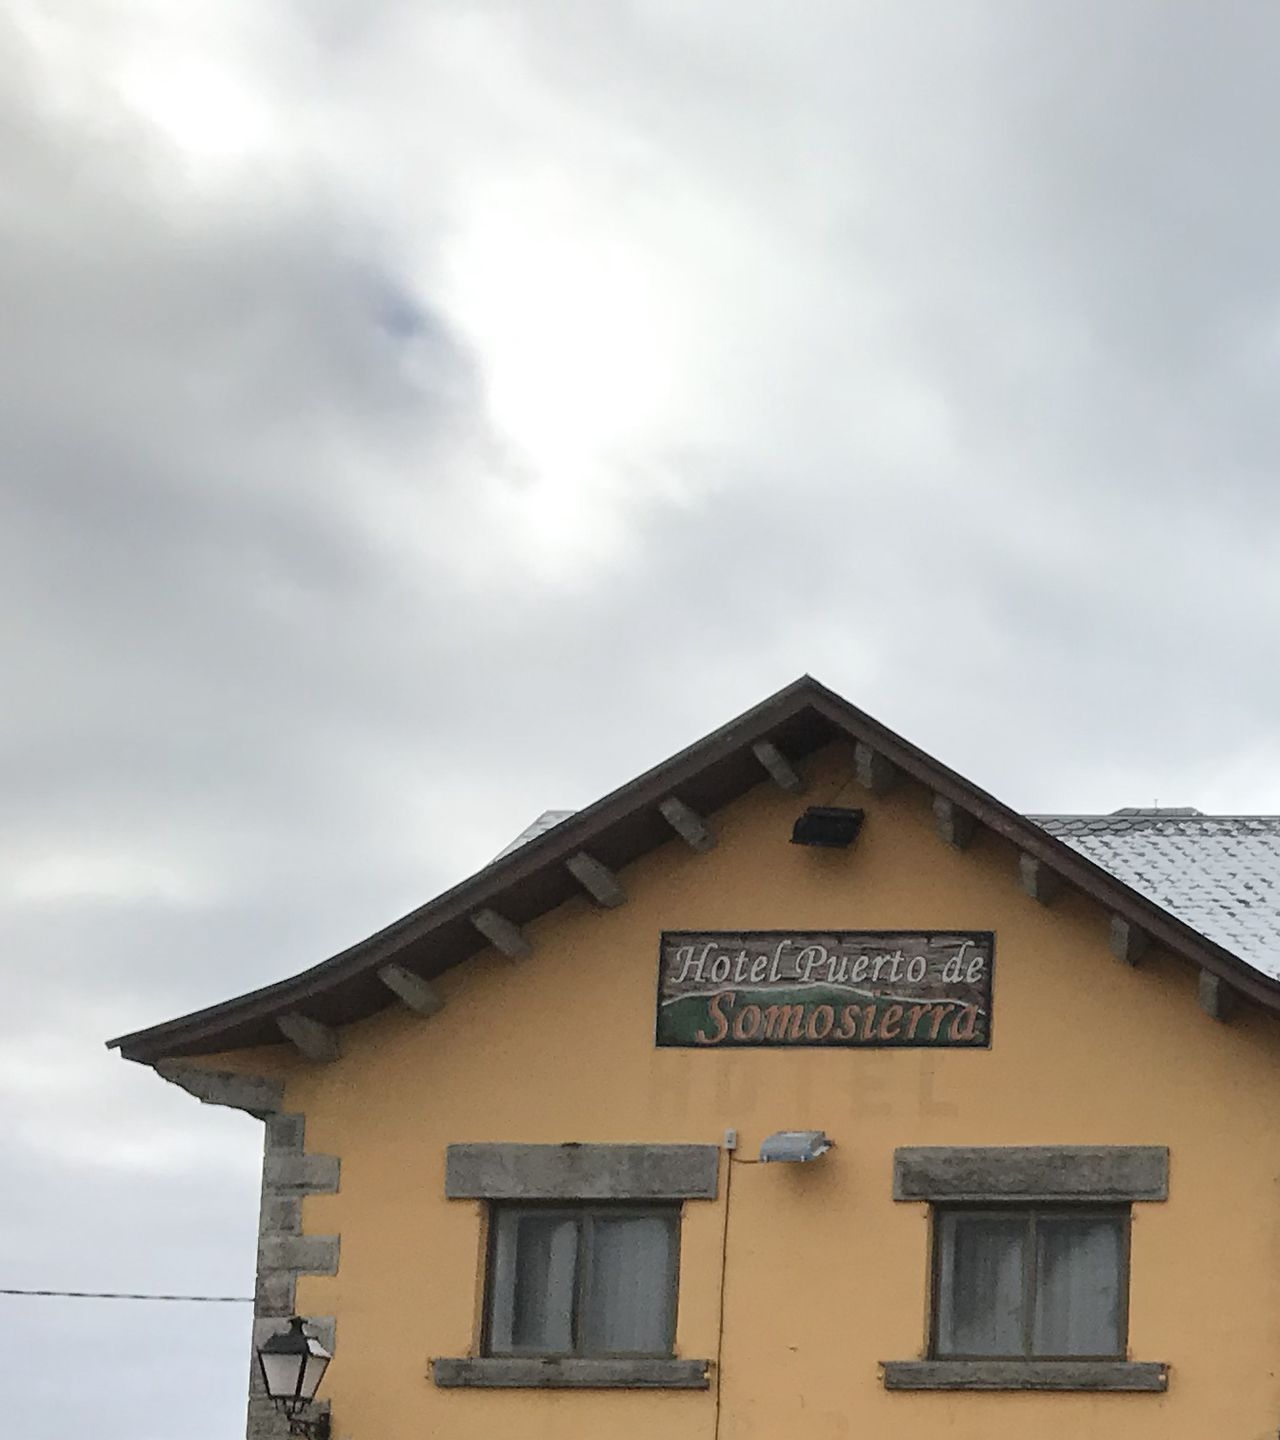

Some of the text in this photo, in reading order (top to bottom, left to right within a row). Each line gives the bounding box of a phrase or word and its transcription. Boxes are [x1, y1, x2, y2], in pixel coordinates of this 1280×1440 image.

[670, 940, 986, 984] Hotel Puerto de
[695, 989, 981, 1044] Somosierra
